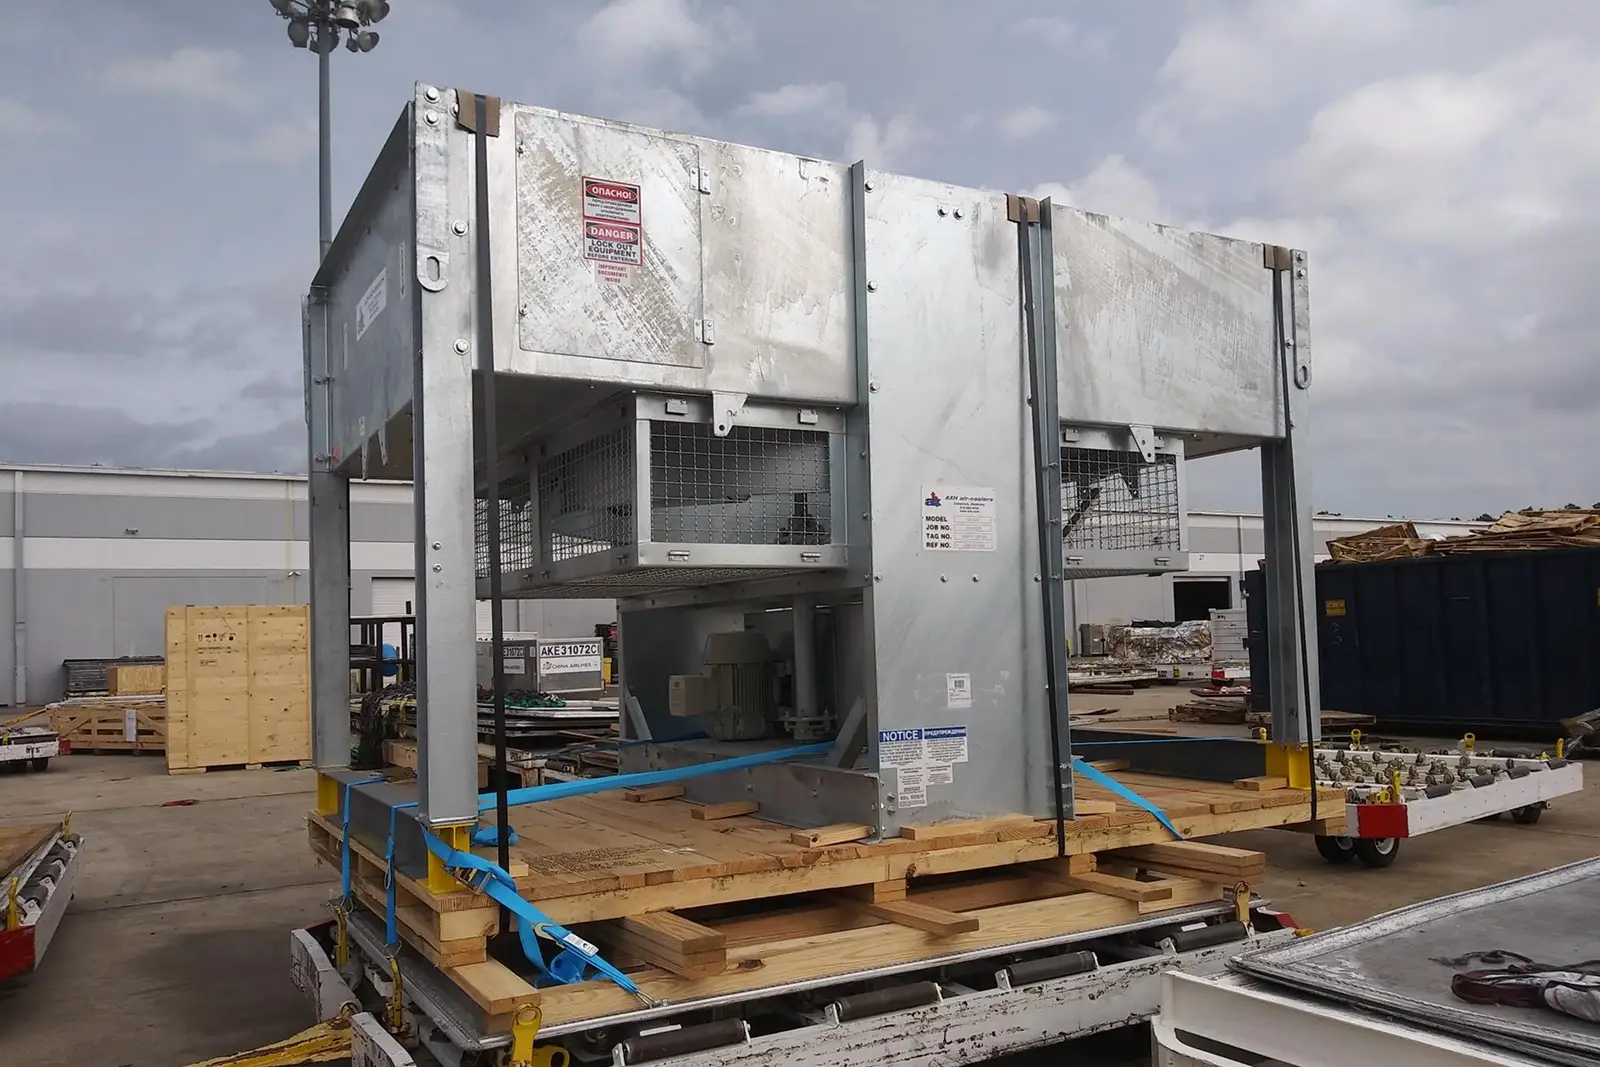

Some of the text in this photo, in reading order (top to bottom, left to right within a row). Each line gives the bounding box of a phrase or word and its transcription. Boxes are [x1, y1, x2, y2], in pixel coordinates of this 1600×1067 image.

[592, 186, 631, 199] ОПАСНО!
[591, 227, 634, 240] DANGER
[588, 246, 636, 258] EQUIPMENT
[592, 240, 633, 252] LOCK OUT
[610, 256, 638, 264] ENTERING
[598, 270, 628, 278] DOCUMENTS
[882, 730, 919, 742] NOTICE
